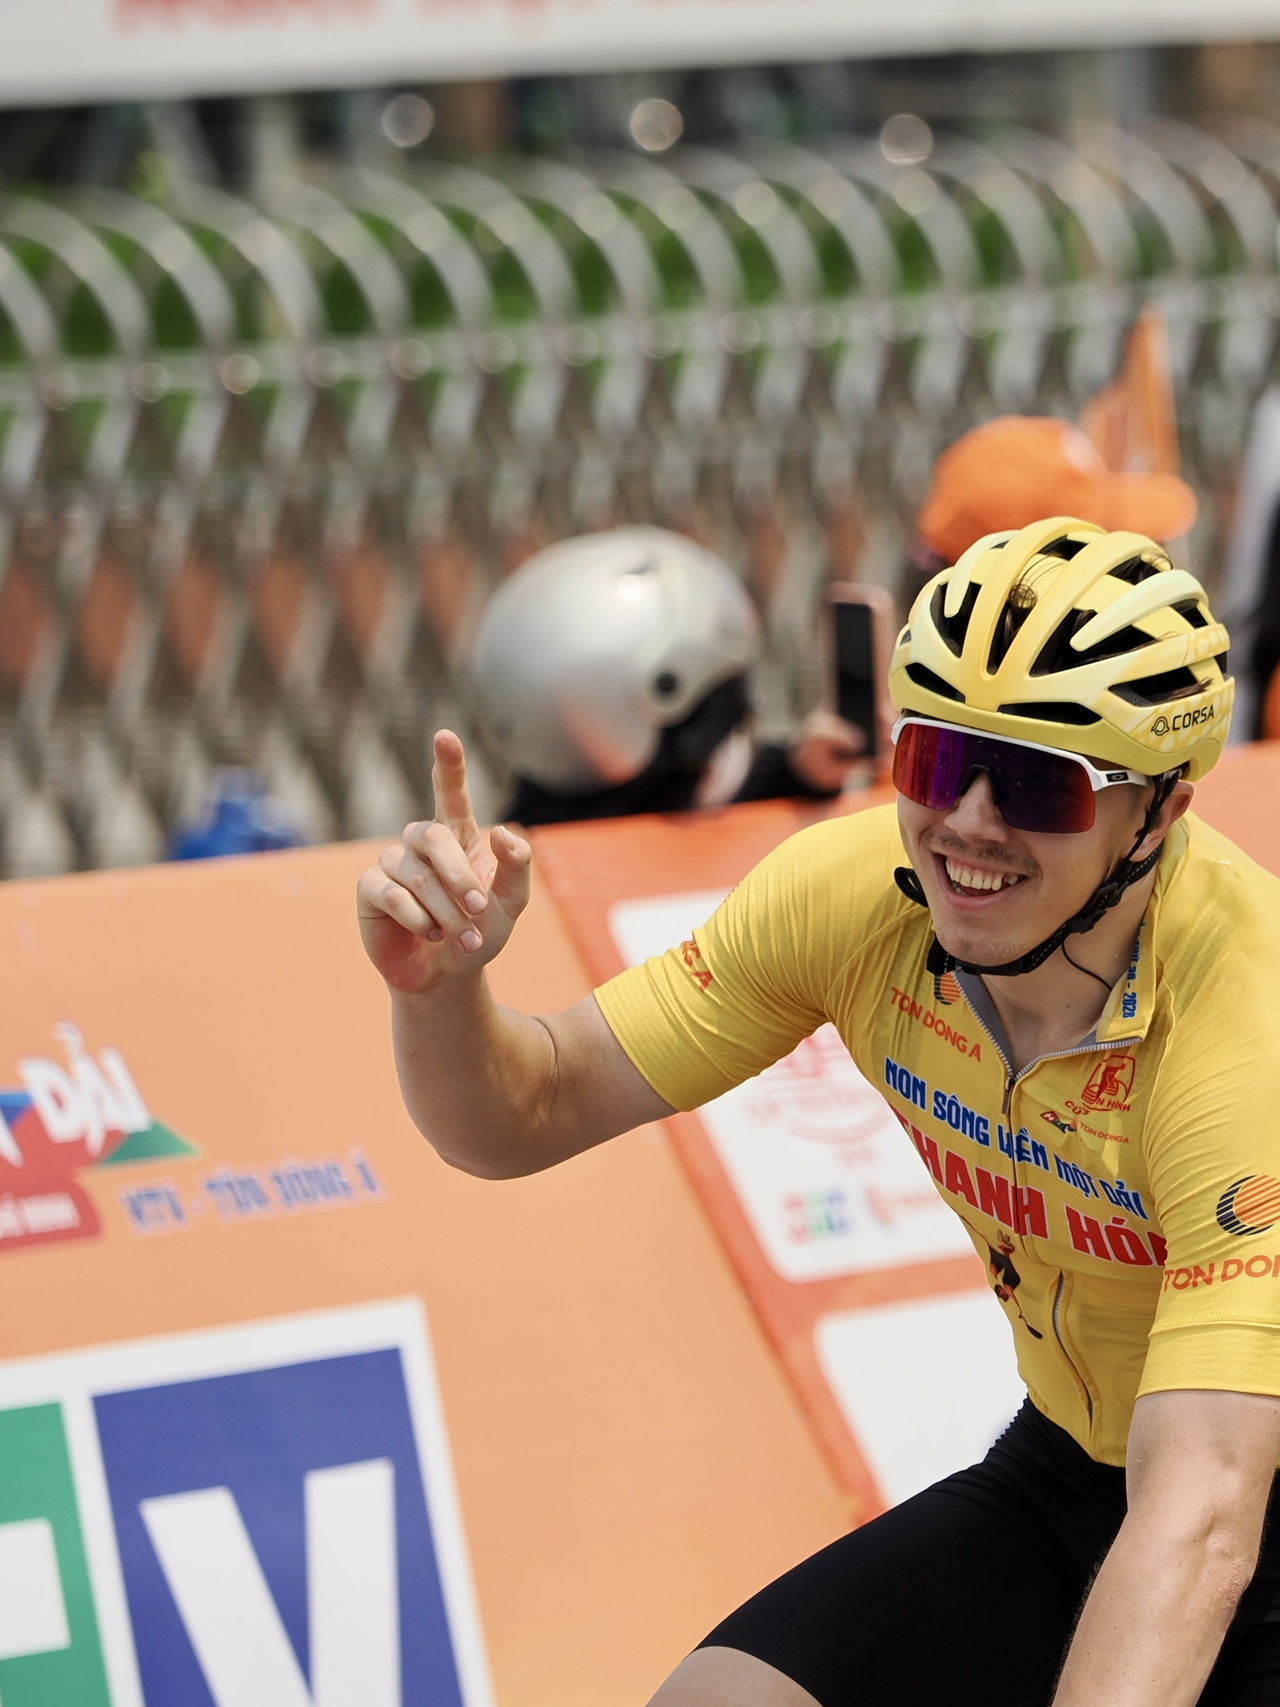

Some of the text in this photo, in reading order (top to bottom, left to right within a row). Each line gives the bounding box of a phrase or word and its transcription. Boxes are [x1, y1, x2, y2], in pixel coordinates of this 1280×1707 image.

[1172, 705, 1214, 731] CORSA
[890, 986, 981, 1063] TON DONG A
[884, 1057, 927, 1110] NON
[933, 1089, 990, 1147] SÔNG
[1080, 1121, 1097, 1136] TON
[1097, 1131, 1123, 1144] DONG
[1163, 1262, 1215, 1293] TON
